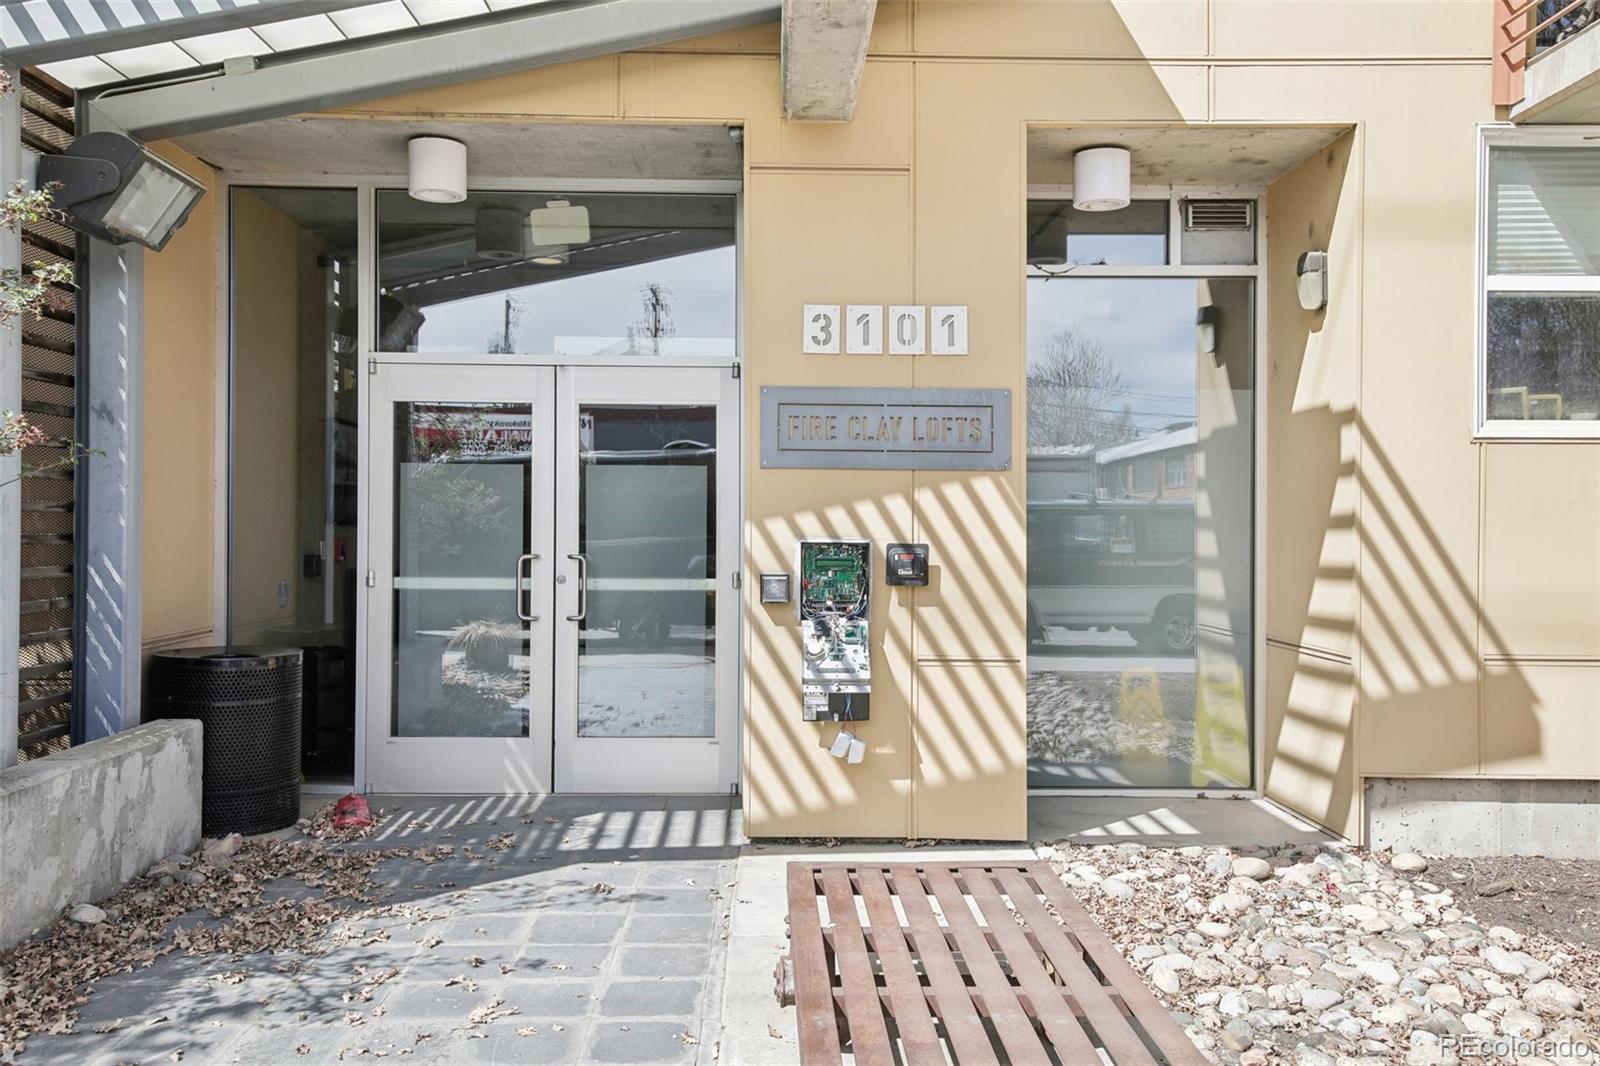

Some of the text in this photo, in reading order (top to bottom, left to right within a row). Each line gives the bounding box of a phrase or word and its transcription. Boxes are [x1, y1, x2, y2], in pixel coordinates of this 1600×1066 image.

[811, 313, 955, 347] 3101
[787, 414, 983, 443] FIRE CLAY LOFTS
